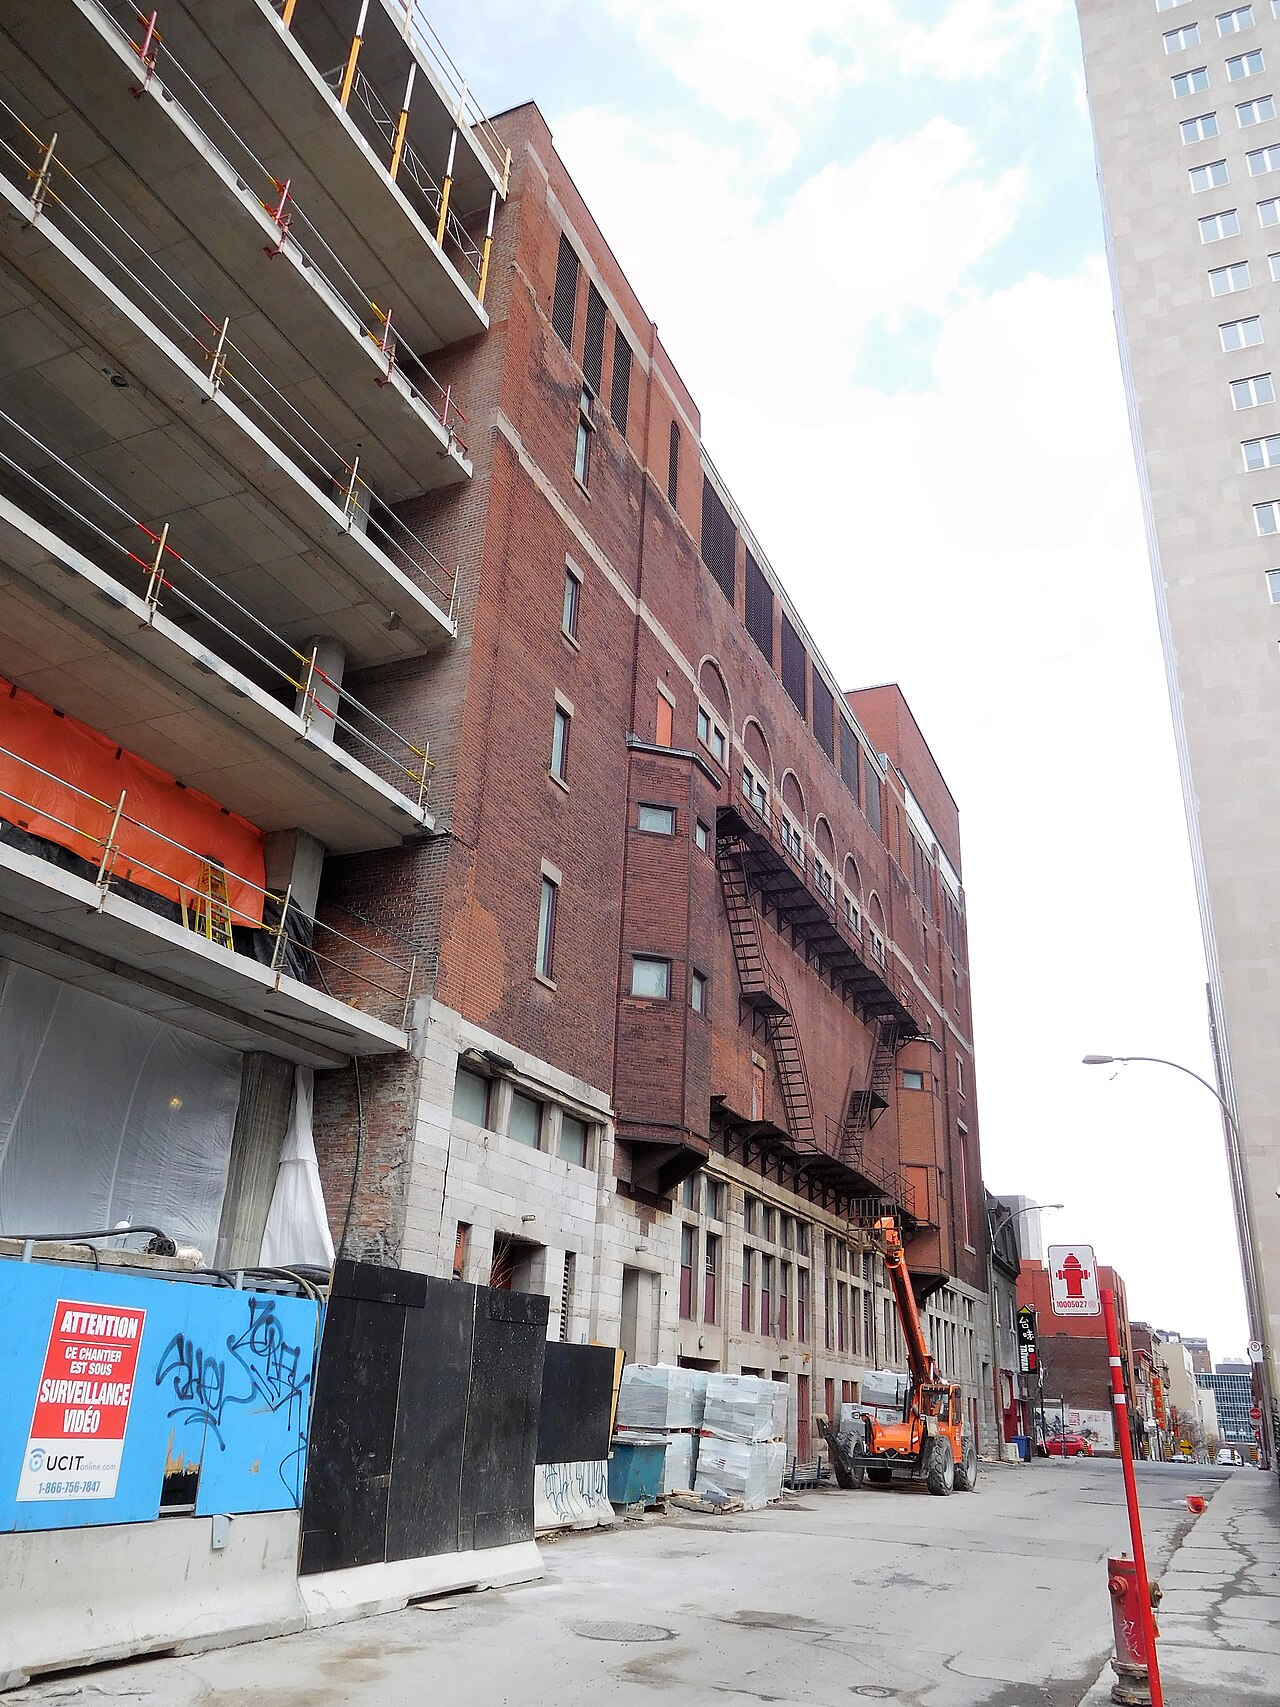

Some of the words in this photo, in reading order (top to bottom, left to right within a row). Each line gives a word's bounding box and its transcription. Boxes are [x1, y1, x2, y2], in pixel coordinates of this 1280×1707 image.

[1056, 1300, 1088, 1309] 10005027
[60, 1310, 139, 1339] ATTENTION
[65, 1346, 78, 1360] CE
[79, 1347, 122, 1363] CHANTIER
[69, 1362, 88, 1374] EST
[88, 1363, 113, 1376] SOUS
[40, 1378, 131, 1406] SURVEILLANCE
[63, 1406, 101, 1433] VIDÉO
[38, 1481, 101, 1494] 1-866-756-7847
